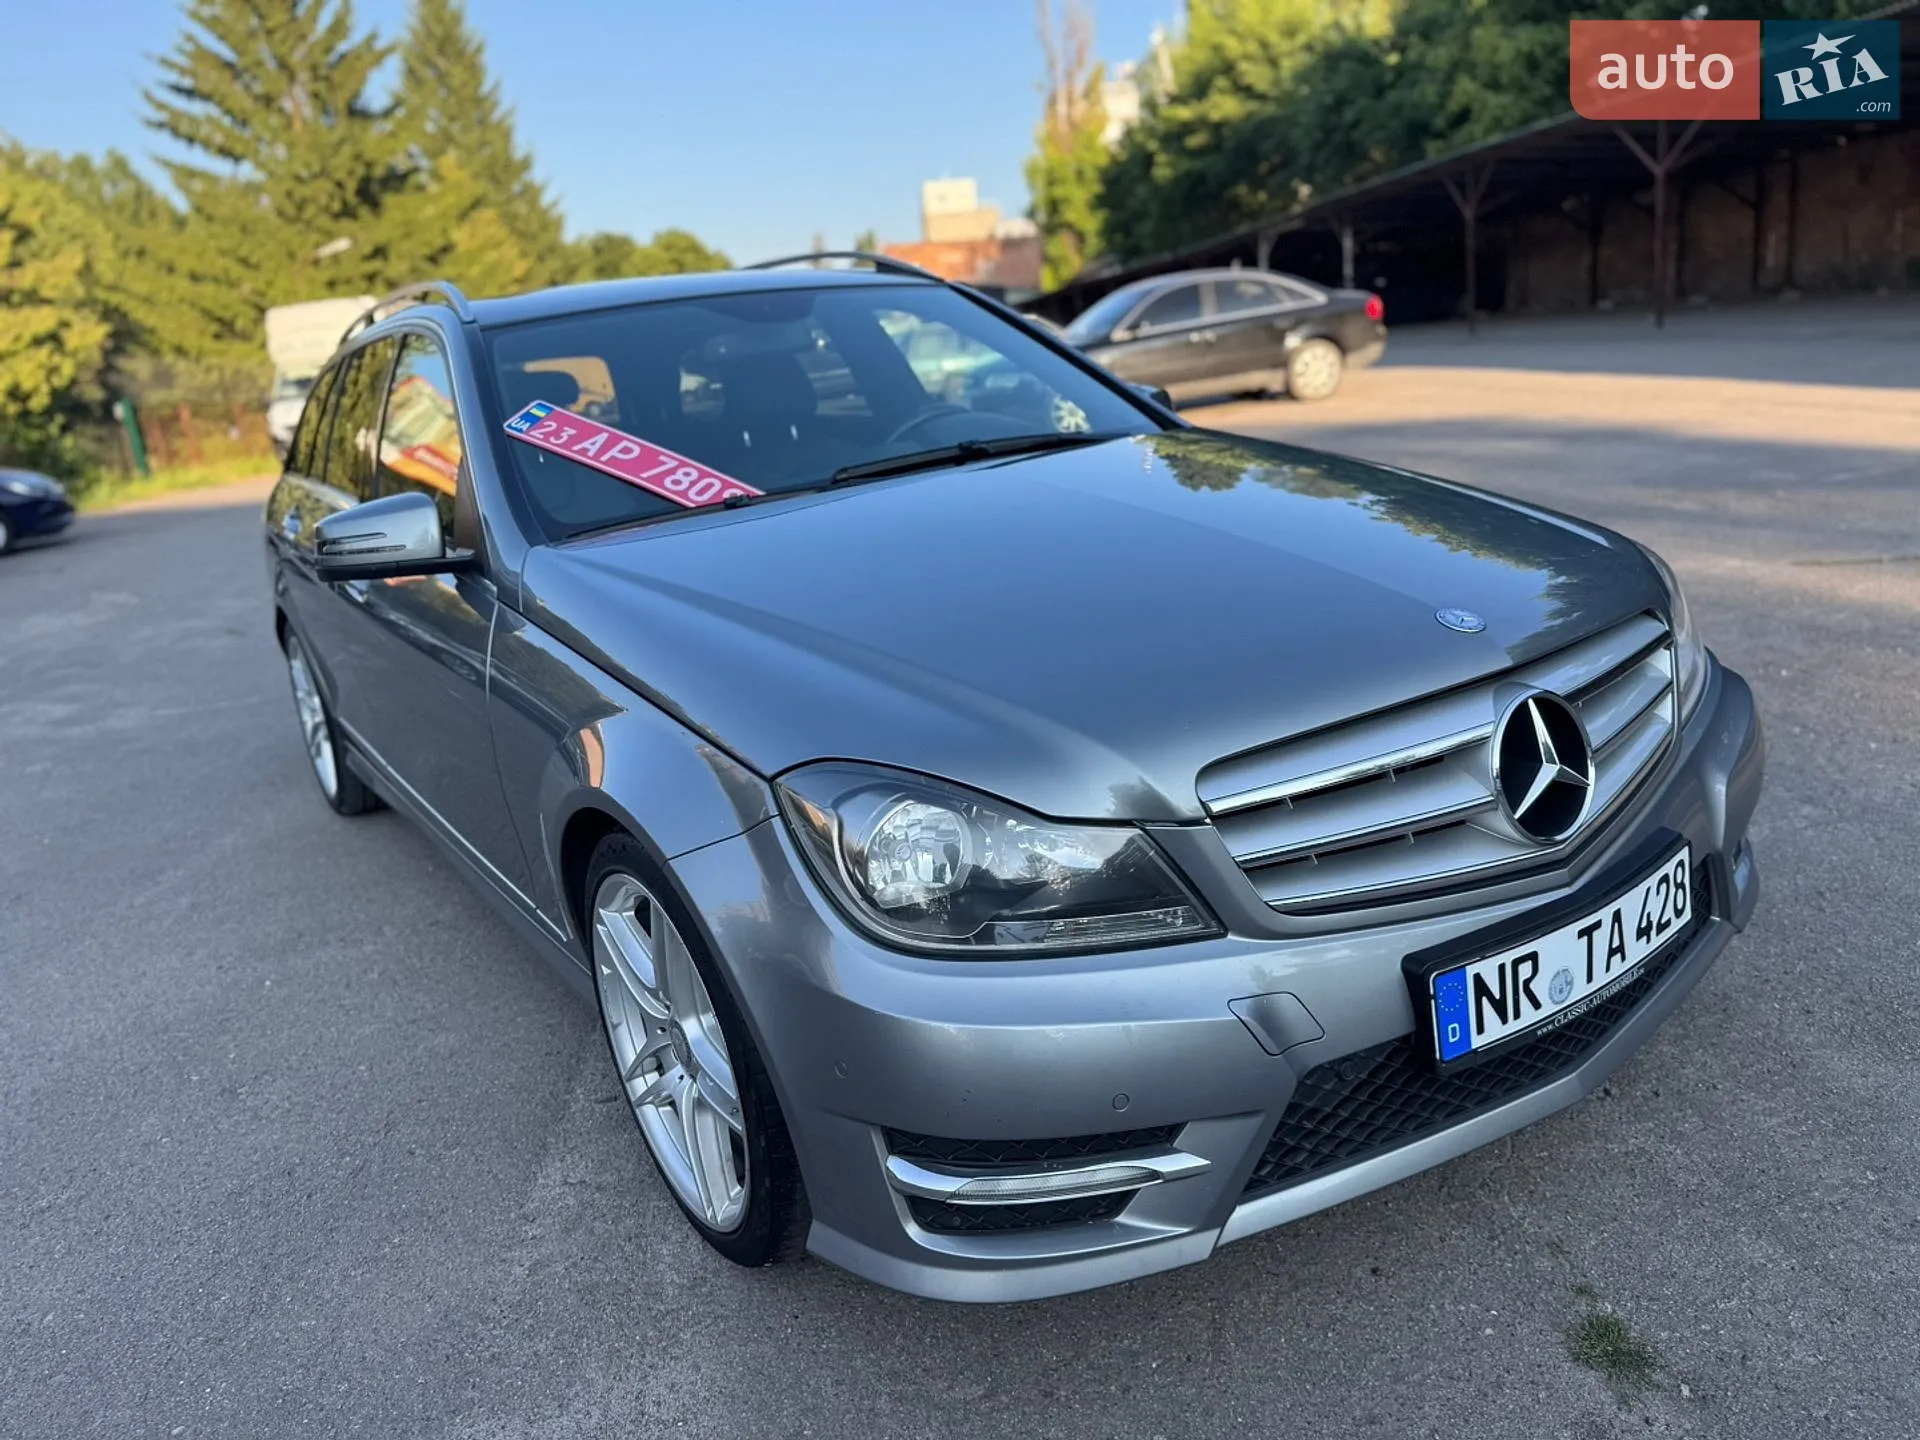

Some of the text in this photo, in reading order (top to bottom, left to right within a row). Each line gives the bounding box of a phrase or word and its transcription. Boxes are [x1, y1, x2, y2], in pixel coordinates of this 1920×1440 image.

[511, 417, 531, 432] UA
[528, 421, 577, 444] 23
[572, 432, 641, 462] AP
[1473, 858, 1687, 1036] NR TA 428
[1448, 1023, 1460, 1043] D
